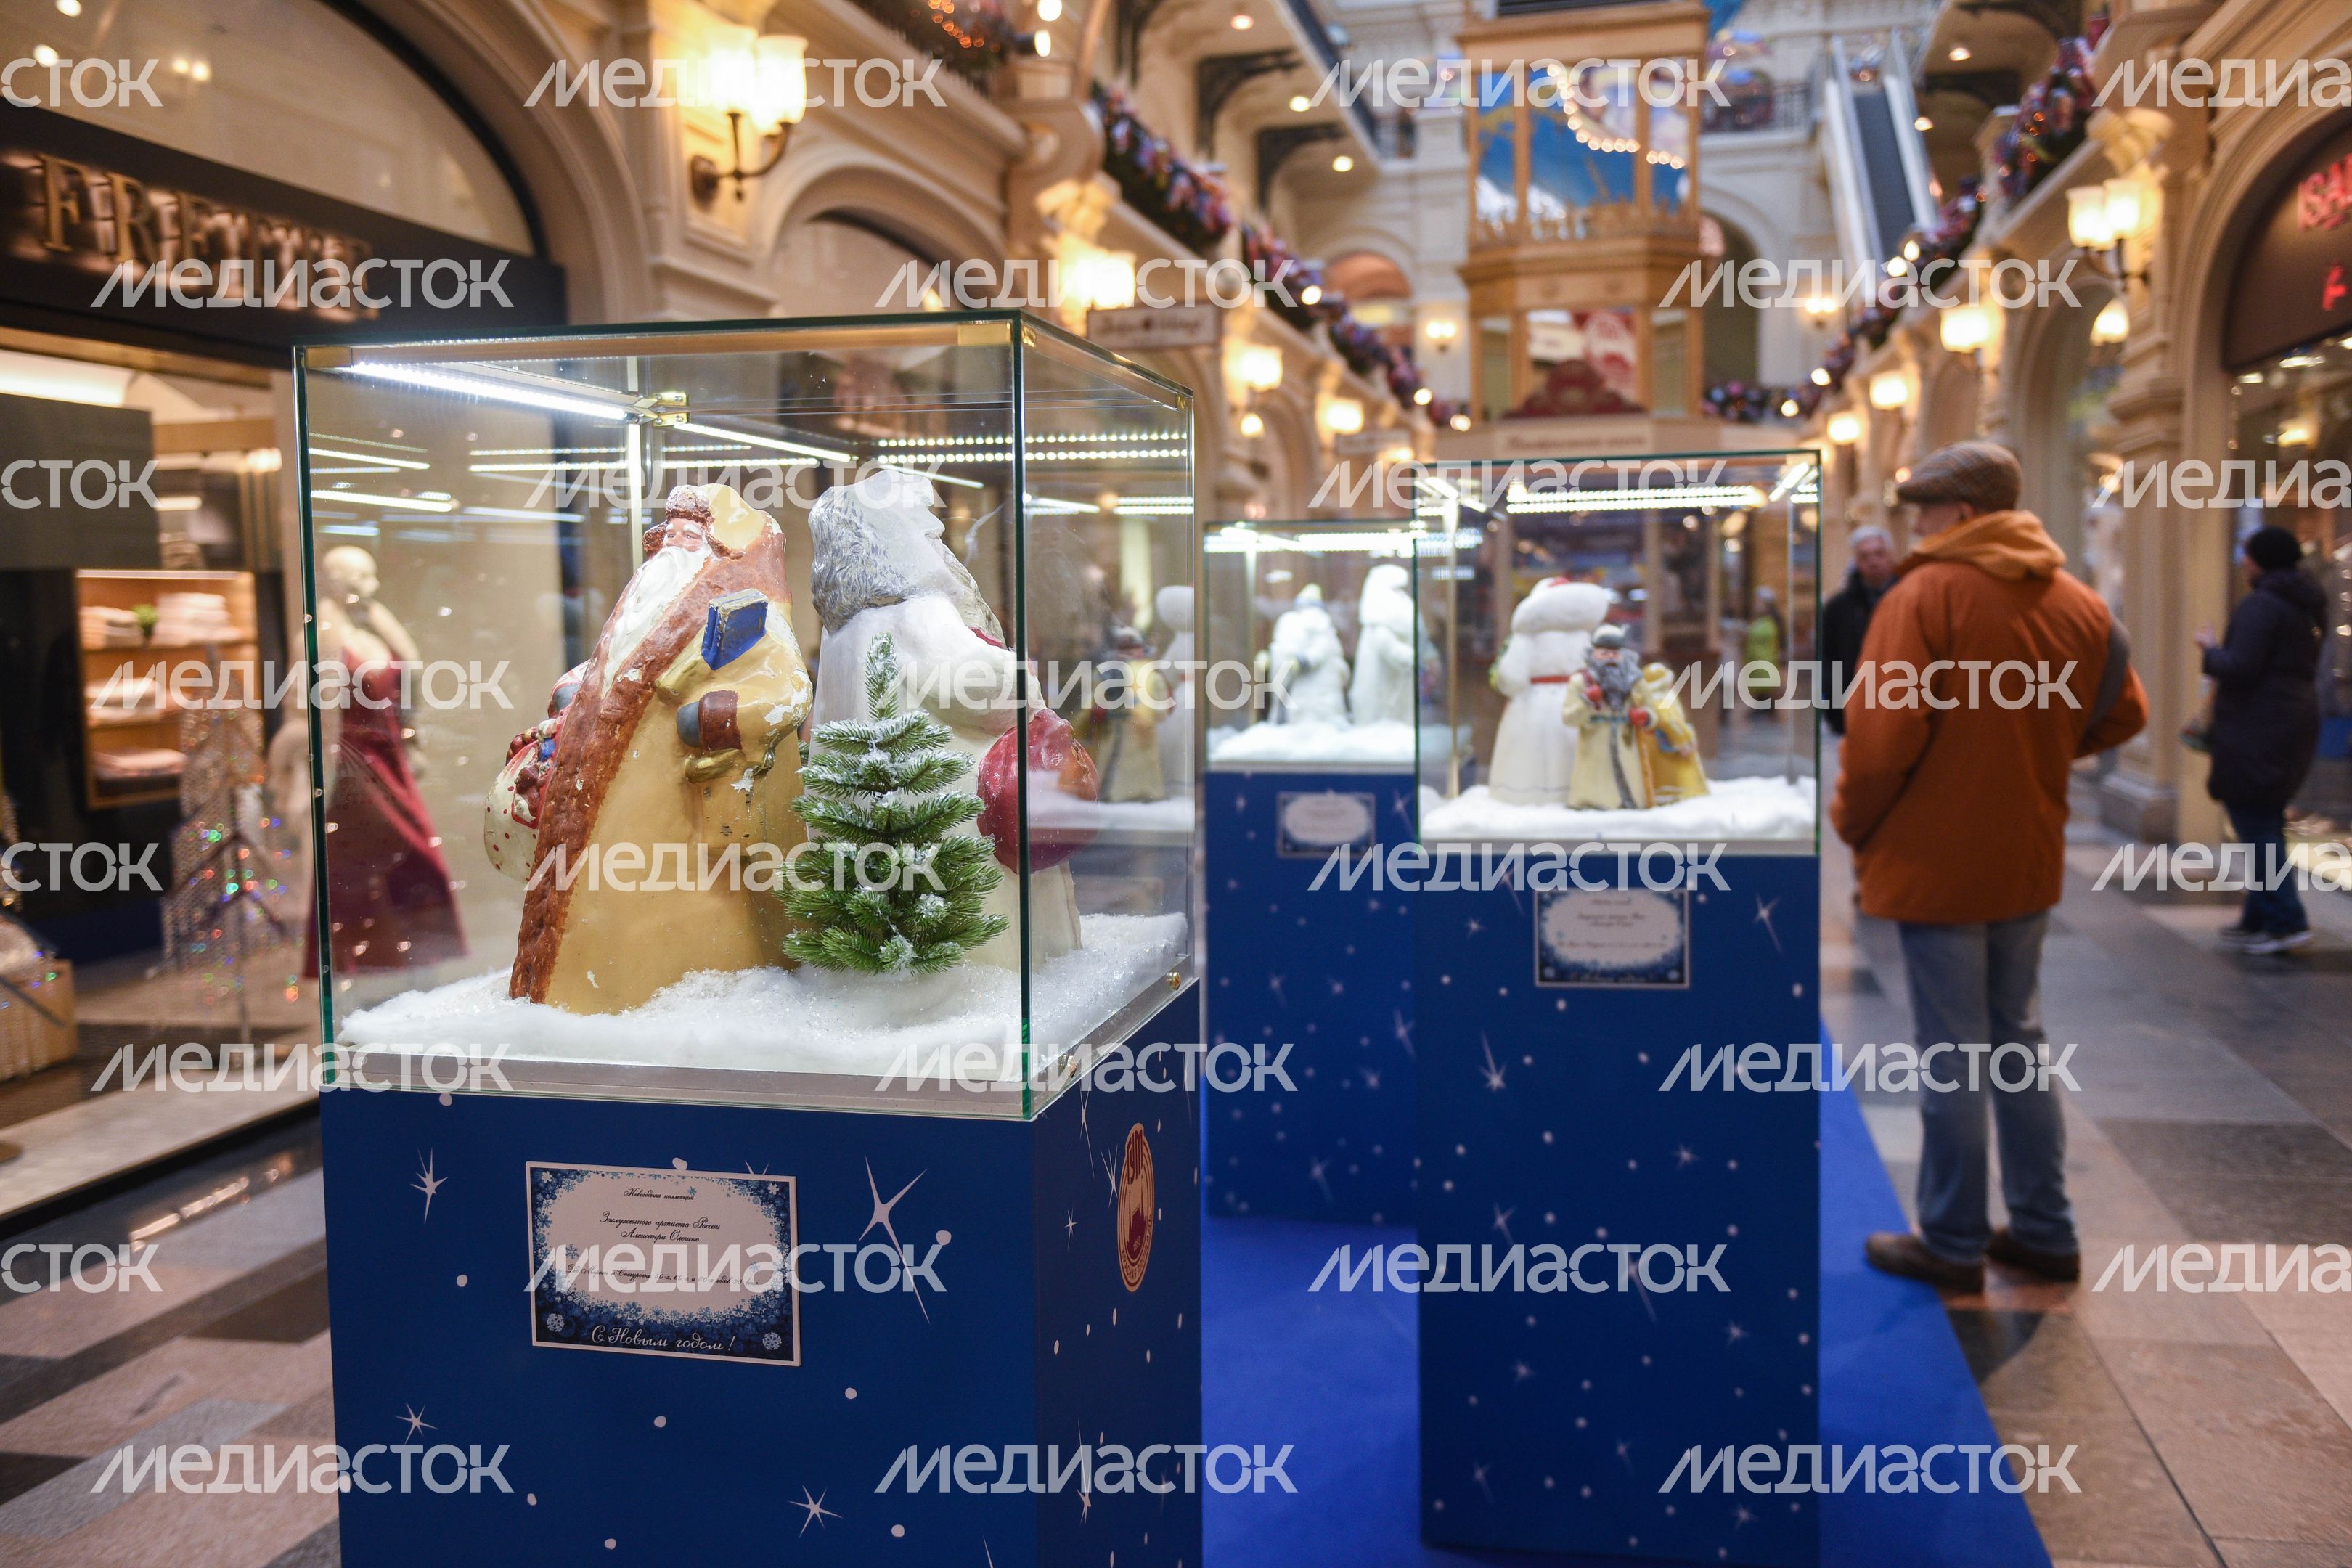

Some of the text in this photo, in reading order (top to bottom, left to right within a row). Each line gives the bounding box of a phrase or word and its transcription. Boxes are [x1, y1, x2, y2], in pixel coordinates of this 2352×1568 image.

[1127, 1129, 1144, 1185] ГУМ
[600, 1211, 721, 1230] Заслуженного артиста России
[669, 1229, 700, 1242] Олешко
[592, 1325, 605, 1343] С
[608, 1327, 668, 1347] Новым
